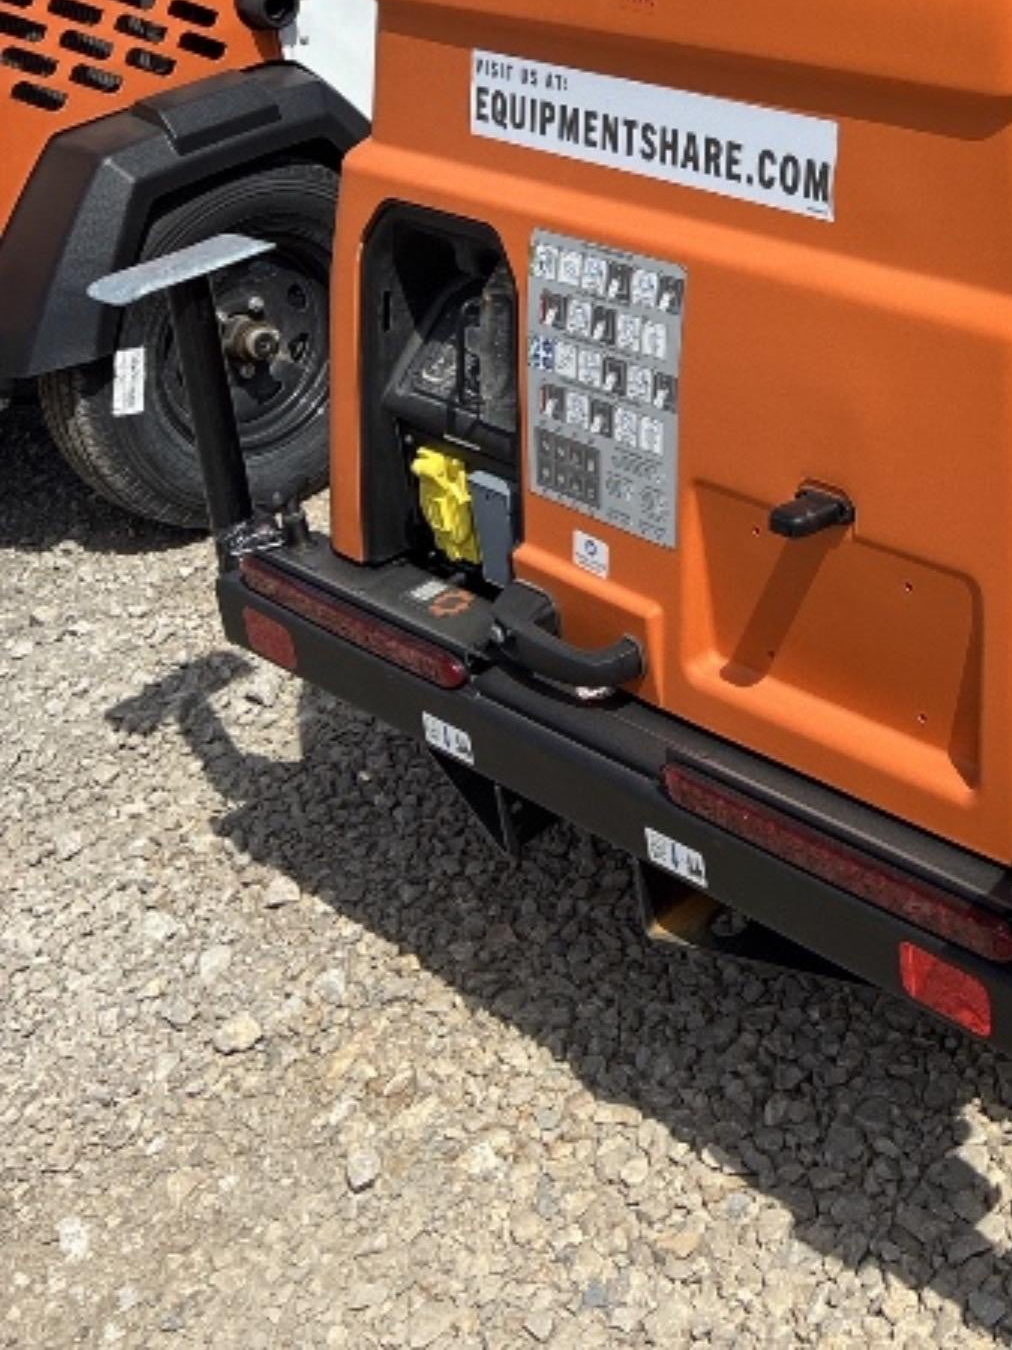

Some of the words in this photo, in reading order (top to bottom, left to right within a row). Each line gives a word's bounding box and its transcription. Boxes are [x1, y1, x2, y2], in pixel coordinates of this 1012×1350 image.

[475, 59, 514, 82] VISIT
[521, 67, 538, 88] US
[474, 86, 832, 205] EQUIPMENTSHARE.COM
